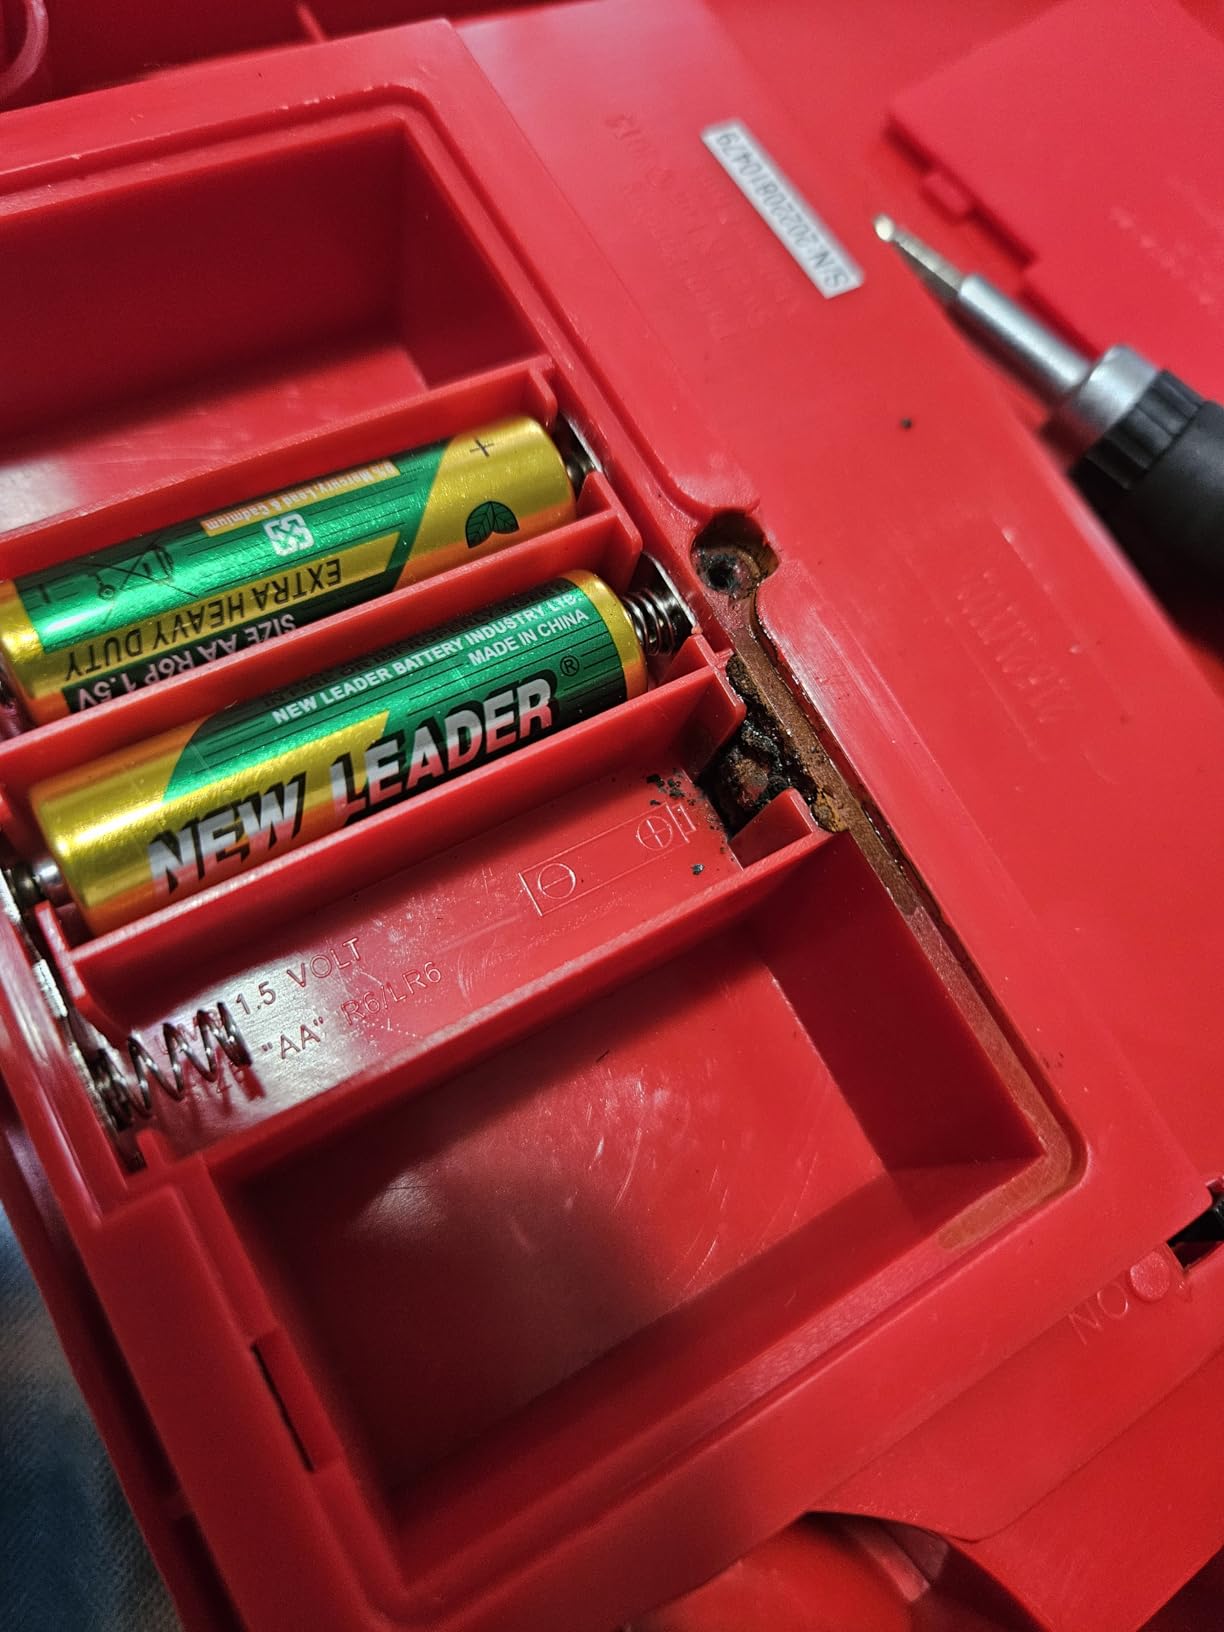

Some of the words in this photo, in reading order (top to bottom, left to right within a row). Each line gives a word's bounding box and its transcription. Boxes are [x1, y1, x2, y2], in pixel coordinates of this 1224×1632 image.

[206, 502, 270, 531] Cadmium
[282, 487, 318, 508] Lead
[252, 558, 342, 611] EXTRA
[152, 592, 244, 650] HEAVY
[197, 633, 238, 662] AA
[244, 613, 297, 643] SIZE
[467, 636, 520, 667] MADE
[518, 628, 538, 646] IN
[537, 609, 590, 637] CHINA
[65, 628, 144, 681] DUTY
[145, 650, 195, 685] R6P
[271, 695, 318, 725] NEW
[319, 667, 393, 705] LEADER
[392, 637, 465, 676] BATTERY
[464, 605, 548, 646] INDUSTRY
[79, 672, 138, 711] 1.5V
[148, 771, 308, 898] NEW
[329, 670, 557, 824] LEADER
[235, 980, 277, 1015] 1.5
[286, 937, 361, 988] VOLT
[261, 1016, 324, 1060] "AA"
[340, 961, 442, 1026] R6/LR6
